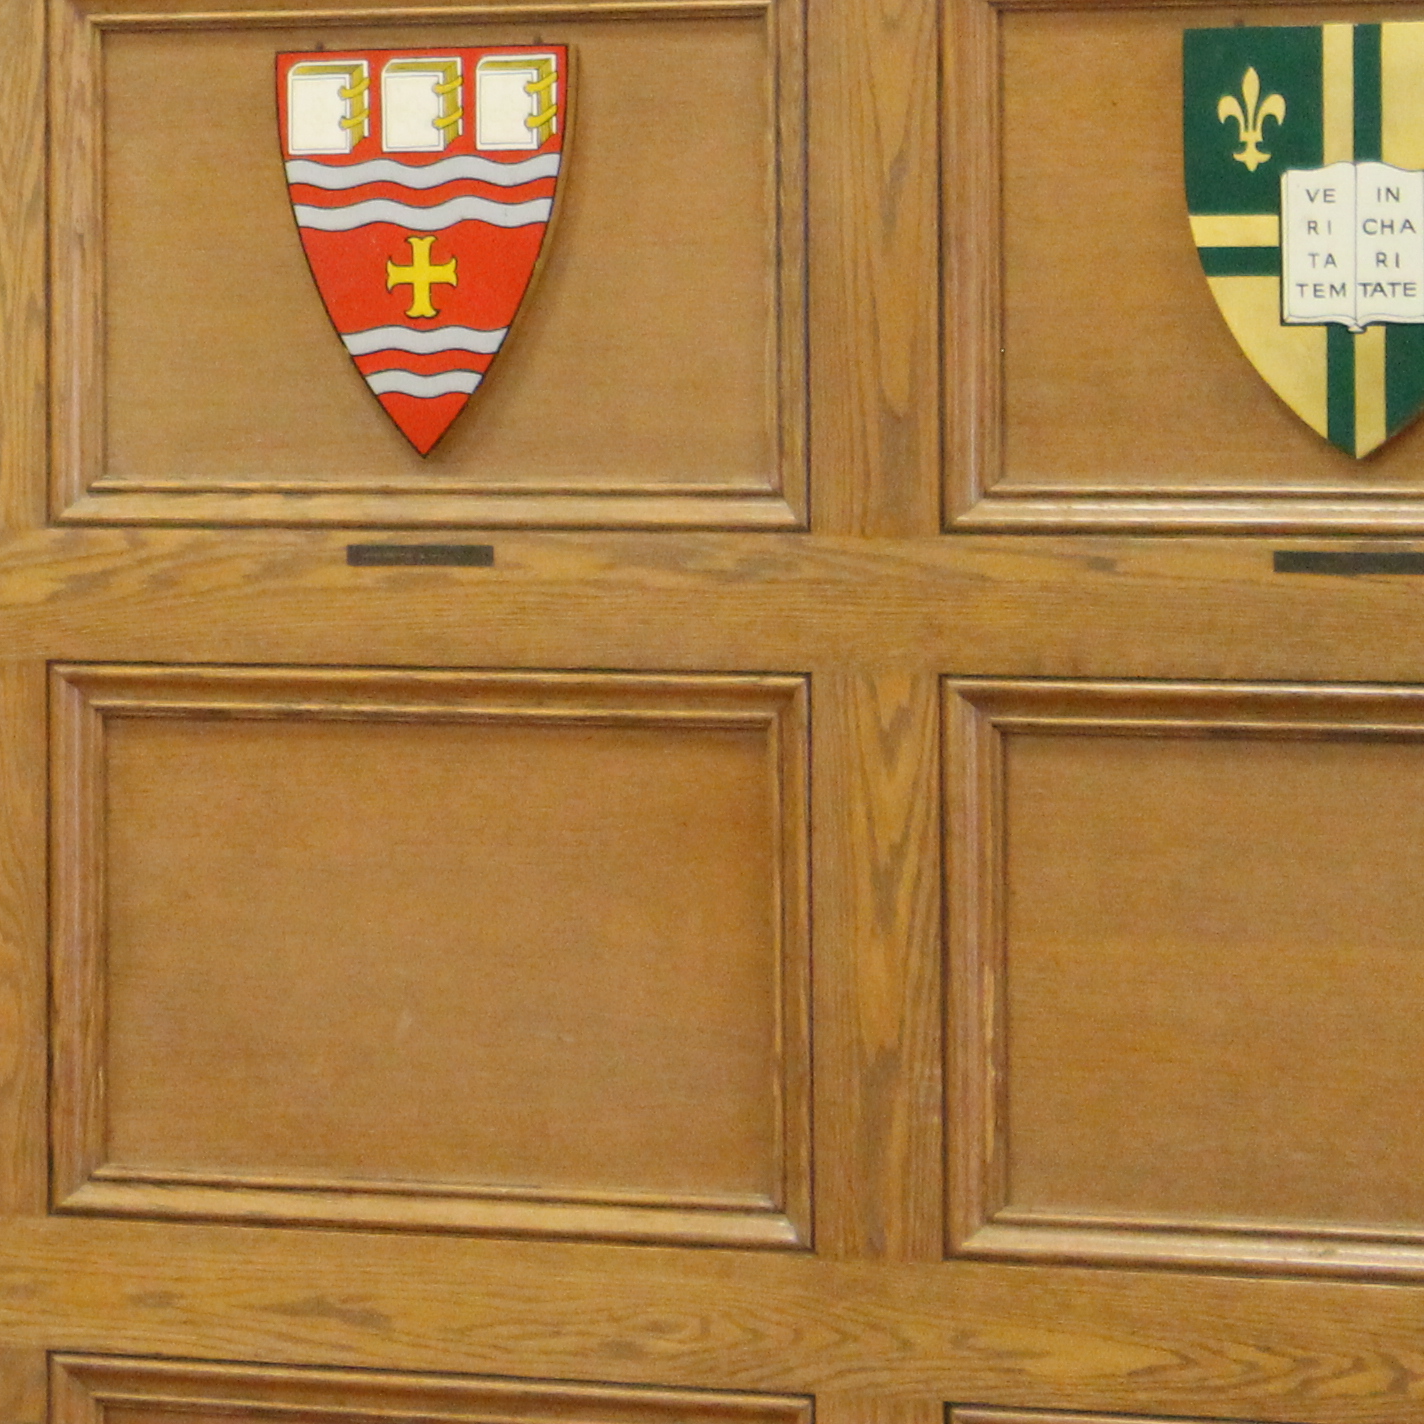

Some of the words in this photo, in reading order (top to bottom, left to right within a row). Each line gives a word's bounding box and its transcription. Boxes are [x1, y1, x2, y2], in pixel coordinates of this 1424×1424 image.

[1305, 187, 1336, 204] VE
[1376, 187, 1400, 203] IN
[1362, 218, 1417, 235] CHA
[1307, 252, 1338, 268] TA
[1295, 282, 1347, 298] TEM
[1357, 282, 1417, 298] TATE
